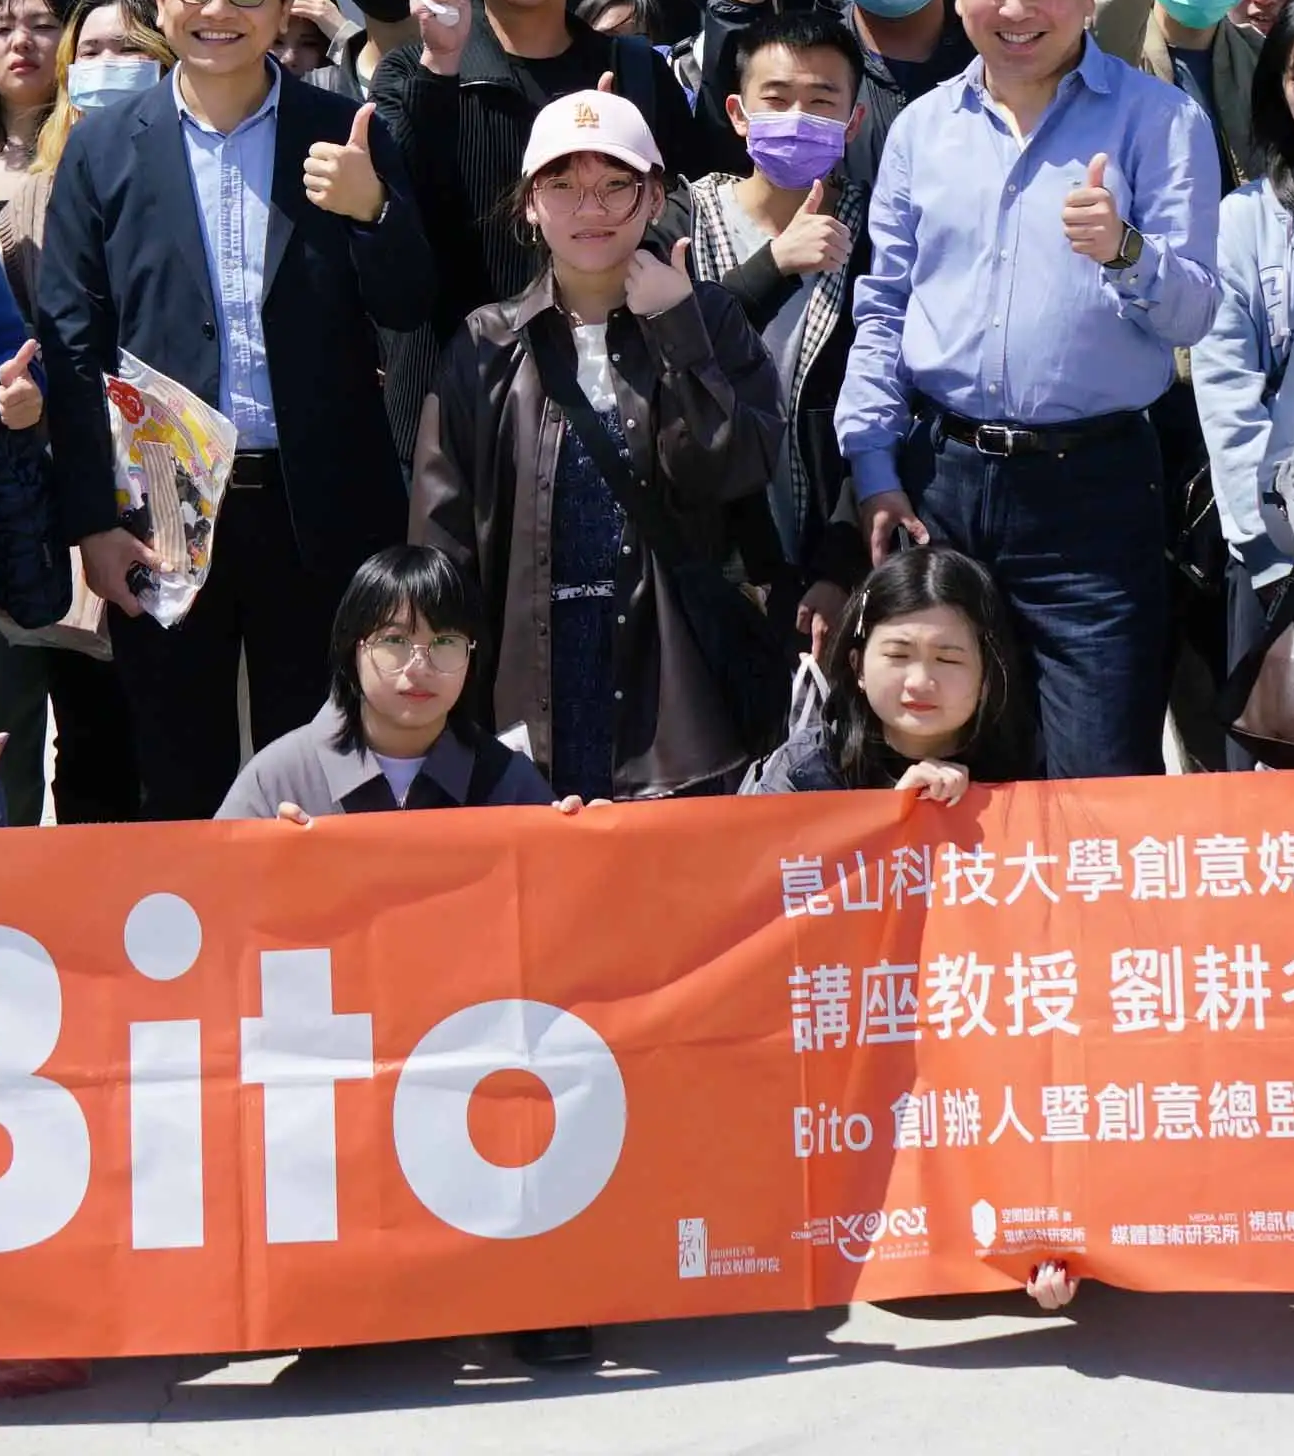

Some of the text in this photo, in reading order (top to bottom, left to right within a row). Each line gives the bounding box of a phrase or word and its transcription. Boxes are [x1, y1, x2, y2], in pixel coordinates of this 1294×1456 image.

[788, 948, 1081, 1054] 講座教授
[793, 1104, 873, 1159] Bito
